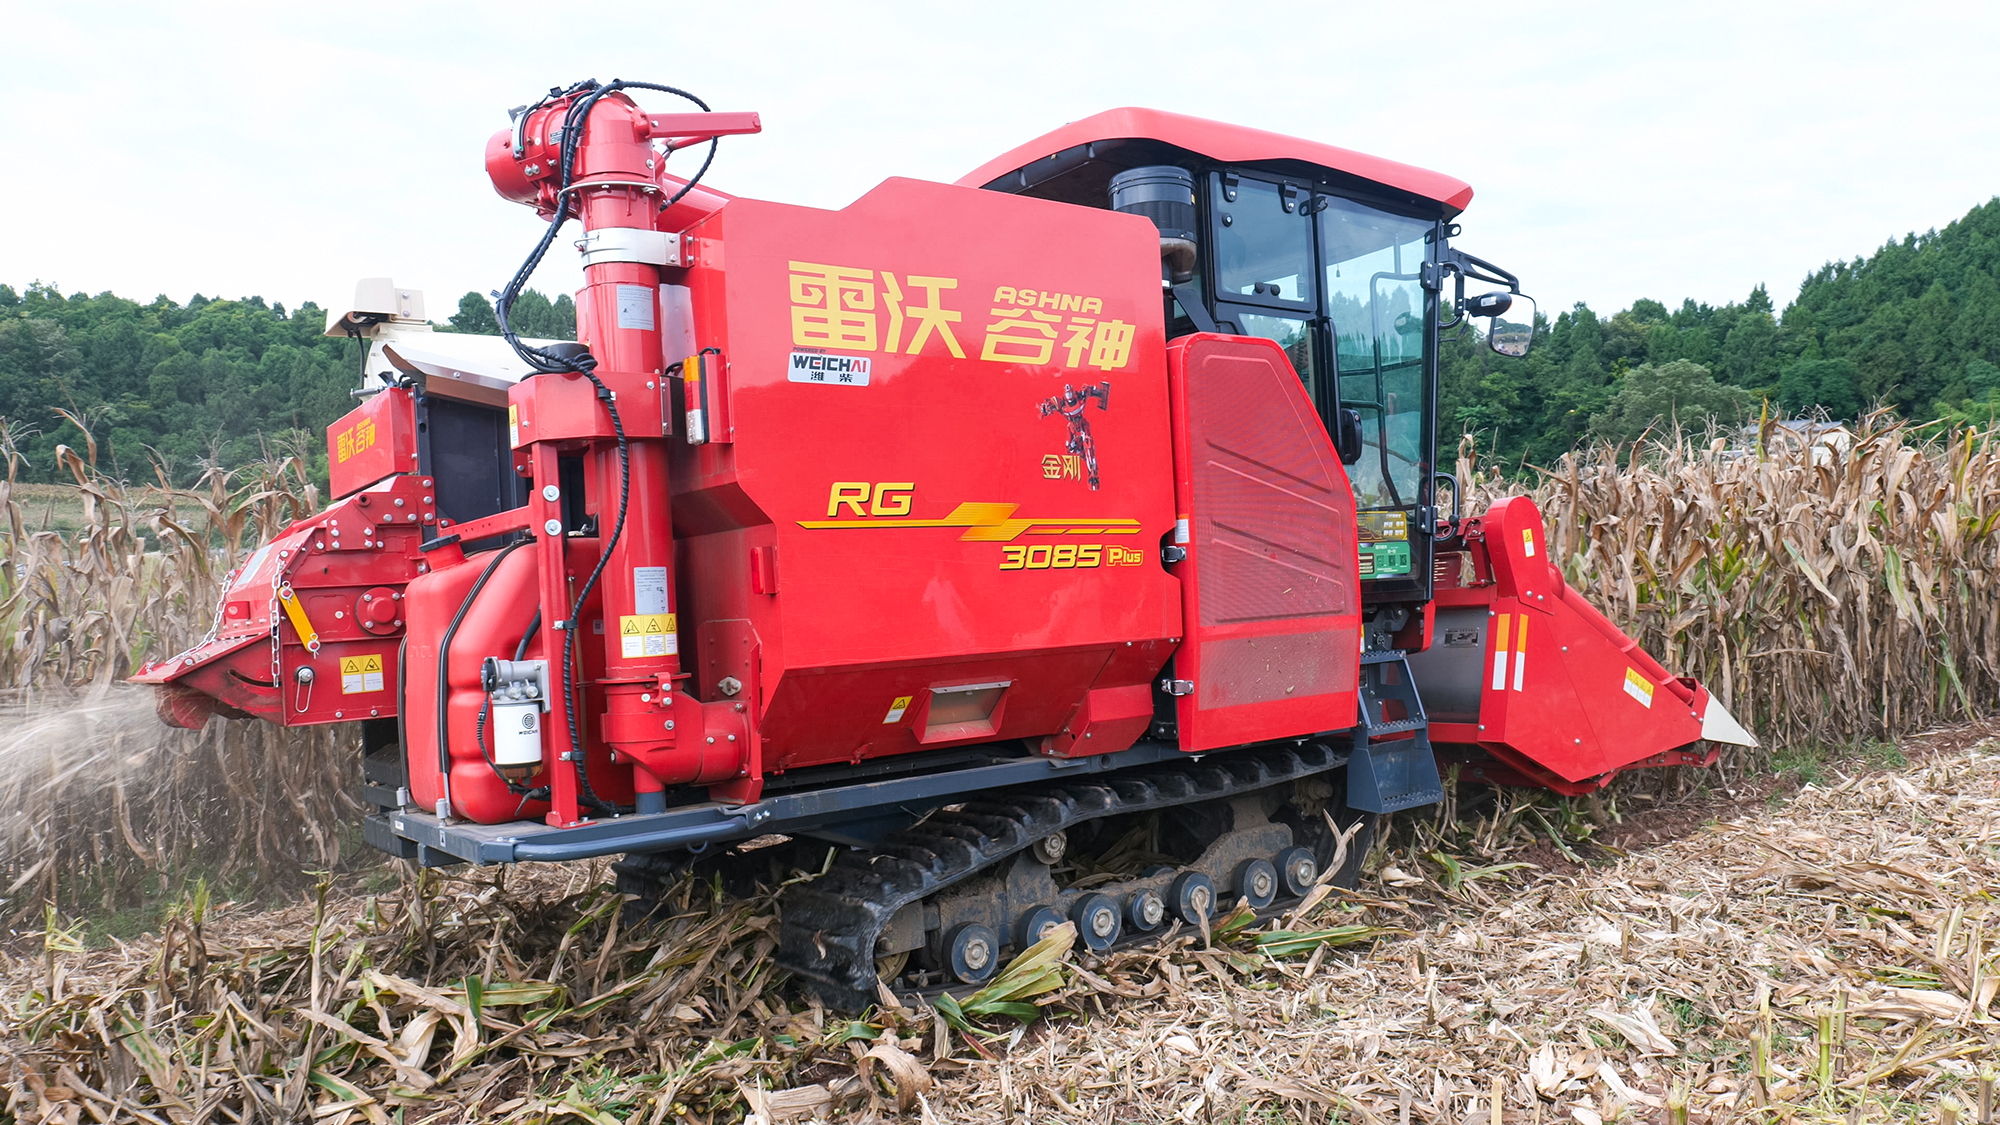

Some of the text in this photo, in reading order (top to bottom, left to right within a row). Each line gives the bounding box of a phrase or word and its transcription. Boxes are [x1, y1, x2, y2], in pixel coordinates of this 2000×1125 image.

[993, 285, 1103, 315] ASHNA
[788, 260, 1136, 371] 雷沃 谷神
[793, 355, 867, 373] WEICHAI
[1041, 454, 1081, 484] 金刚
[827, 481, 915, 517] RG
[999, 544, 1143, 571] 3085 Plus
